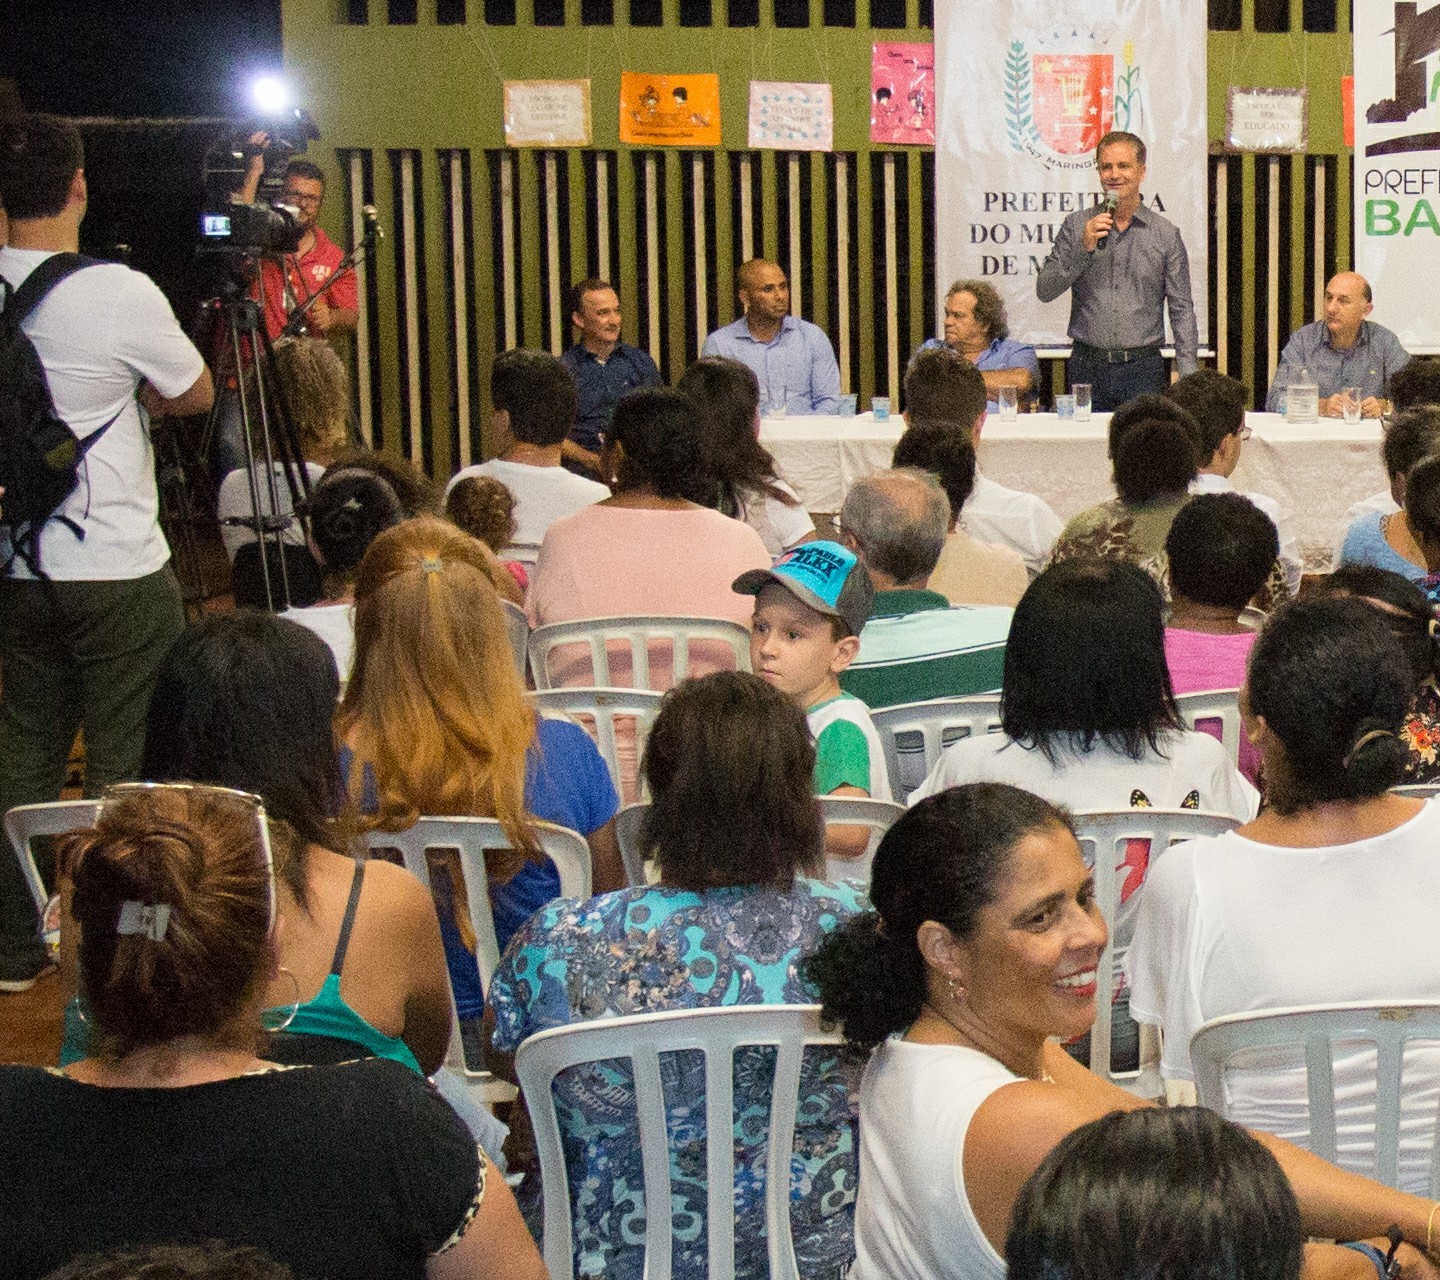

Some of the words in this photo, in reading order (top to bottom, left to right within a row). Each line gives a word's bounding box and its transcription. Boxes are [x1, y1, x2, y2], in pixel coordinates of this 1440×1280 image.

[983, 191, 1167, 213] PREFEITA
[970, 223, 1010, 244] DO
[981, 255, 1018, 276] DE
